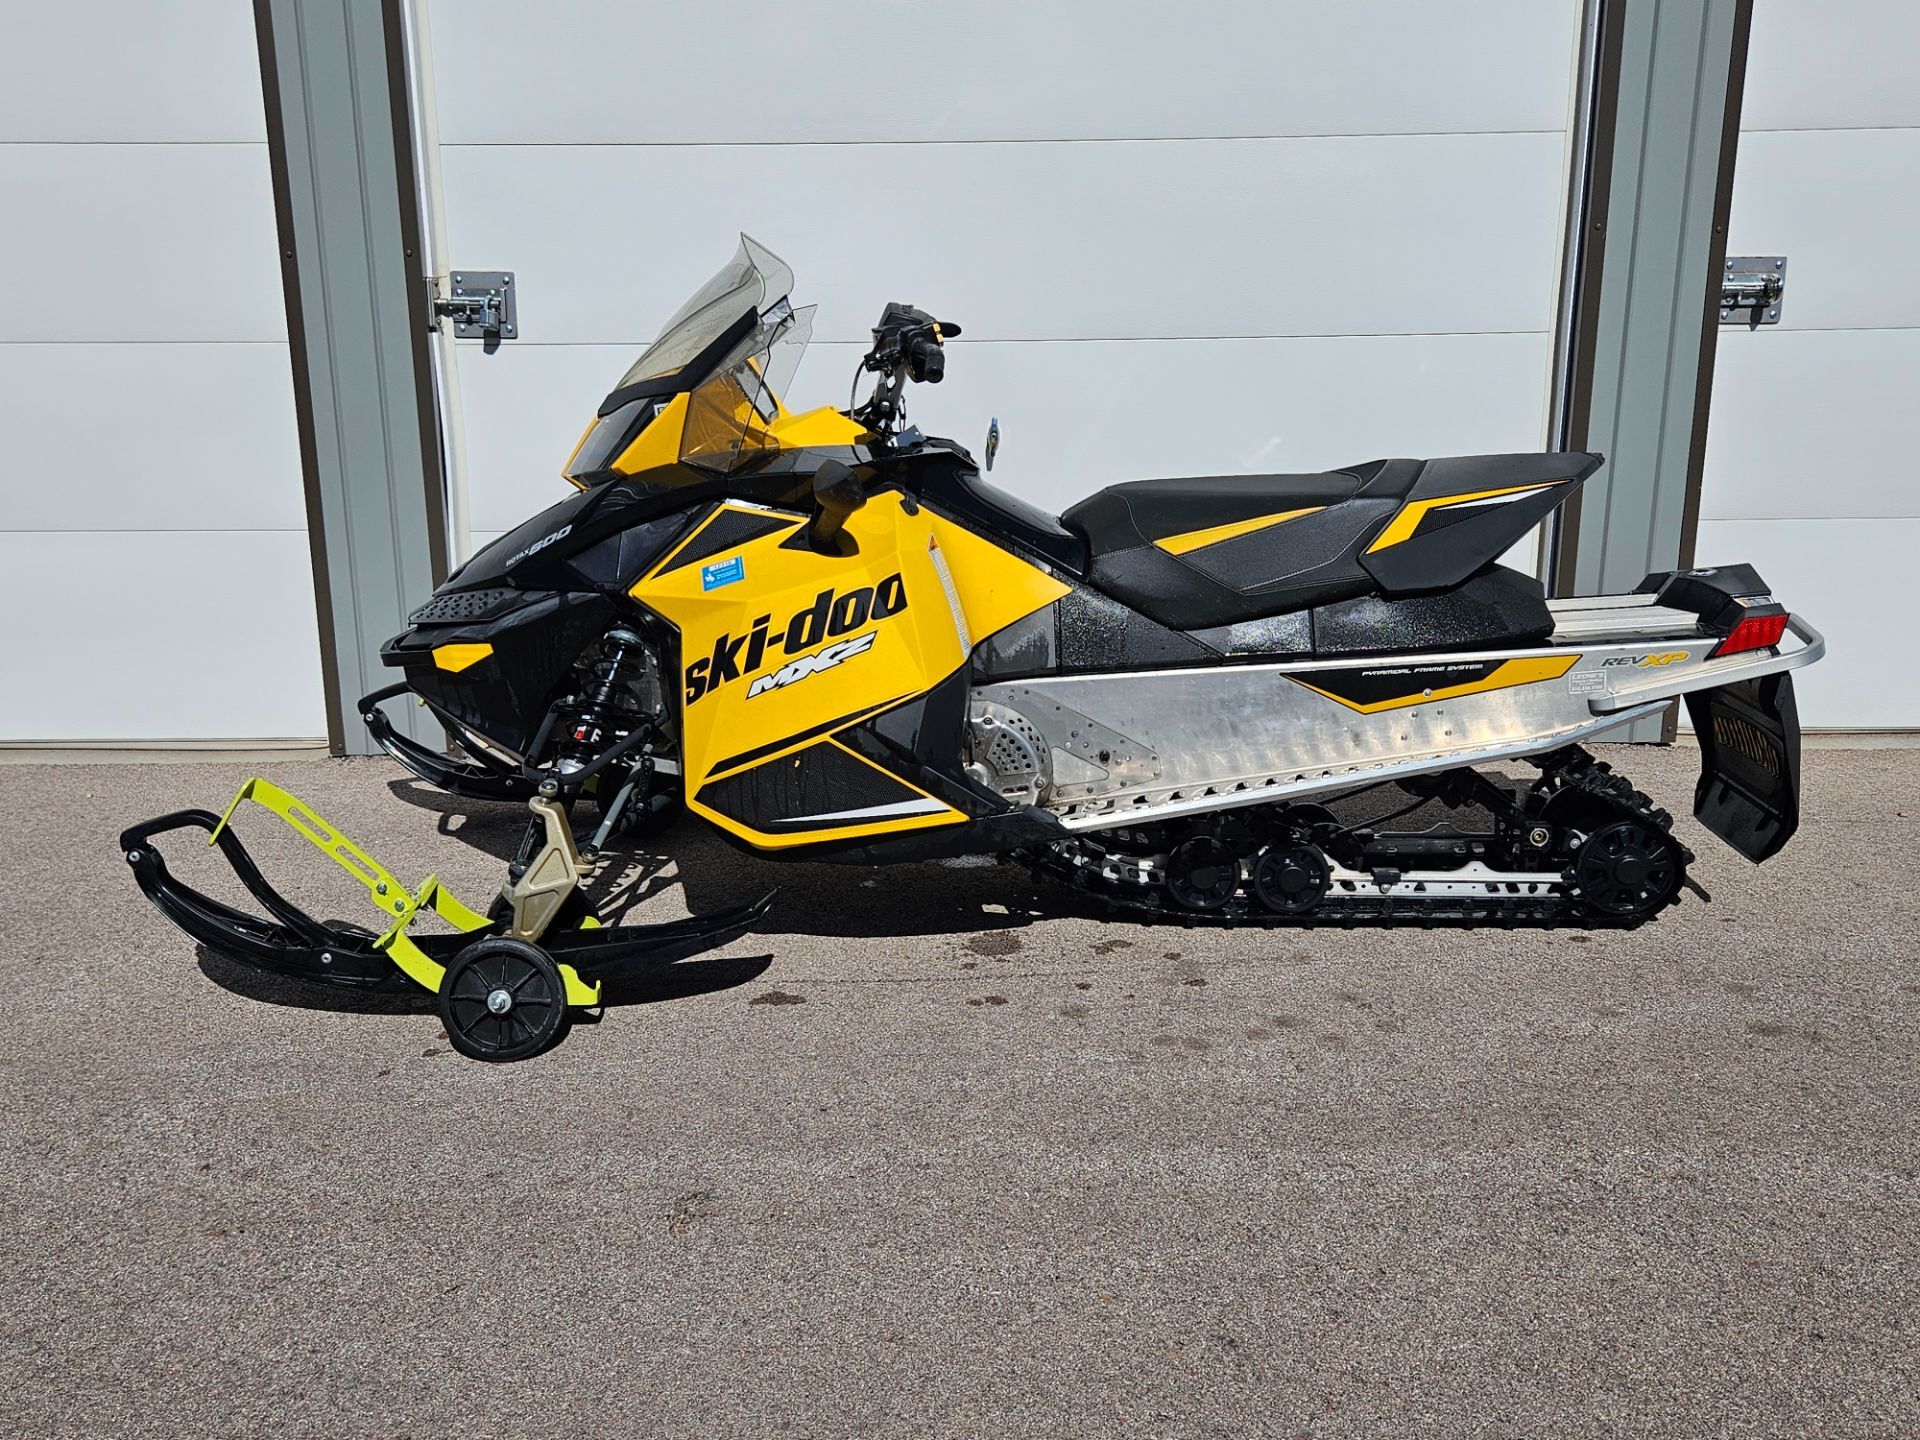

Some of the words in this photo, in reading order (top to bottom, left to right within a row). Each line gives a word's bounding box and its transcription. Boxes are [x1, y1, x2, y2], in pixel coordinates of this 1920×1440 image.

[506, 548, 530, 567] ROTAX
[528, 524, 573, 556] 600
[685, 572, 908, 706] ski-doo
[1361, 668, 1412, 677] PYRAMIDAL
[1446, 663, 1484, 671] SYSTEM
